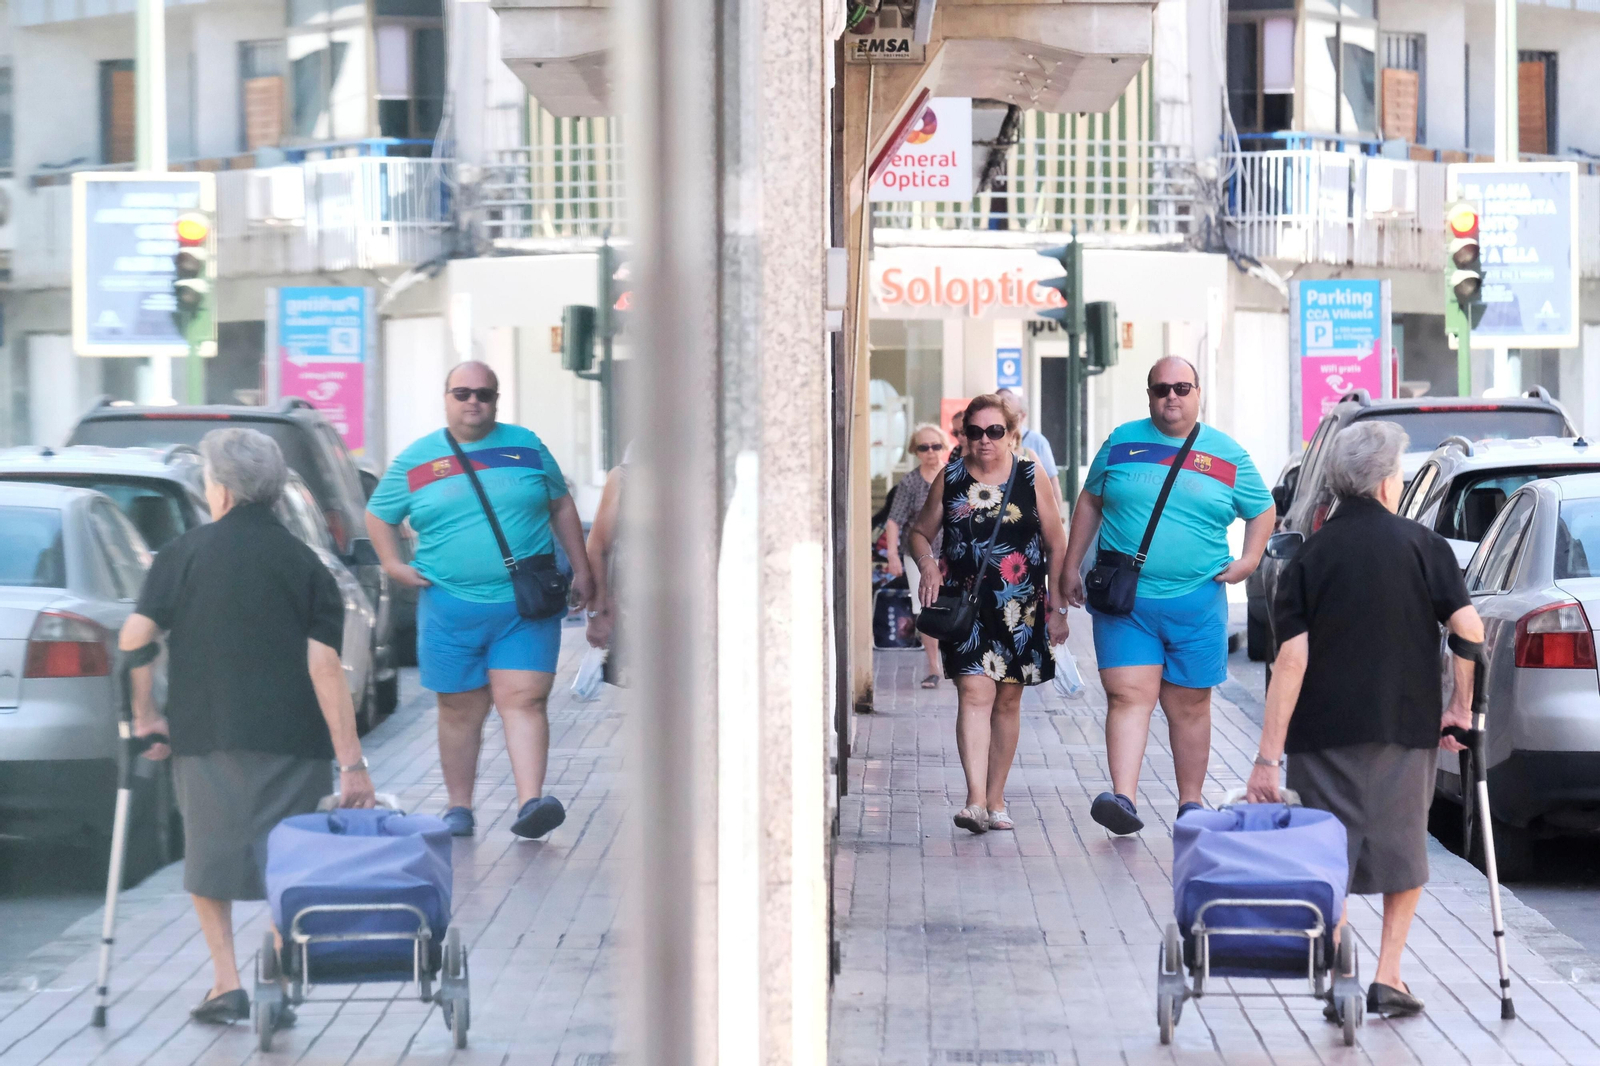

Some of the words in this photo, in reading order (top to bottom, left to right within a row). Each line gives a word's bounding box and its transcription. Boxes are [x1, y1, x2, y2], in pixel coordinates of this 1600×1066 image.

[857, 38, 910, 53] EMSA
[891, 150, 957, 167] eneral
[882, 170, 949, 191] Optica
[882, 266, 1068, 316] Soloptica
[1307, 288, 1373, 308] Parking
[1332, 308, 1374, 320] Viñuela
[1314, 325, 1326, 343] P
